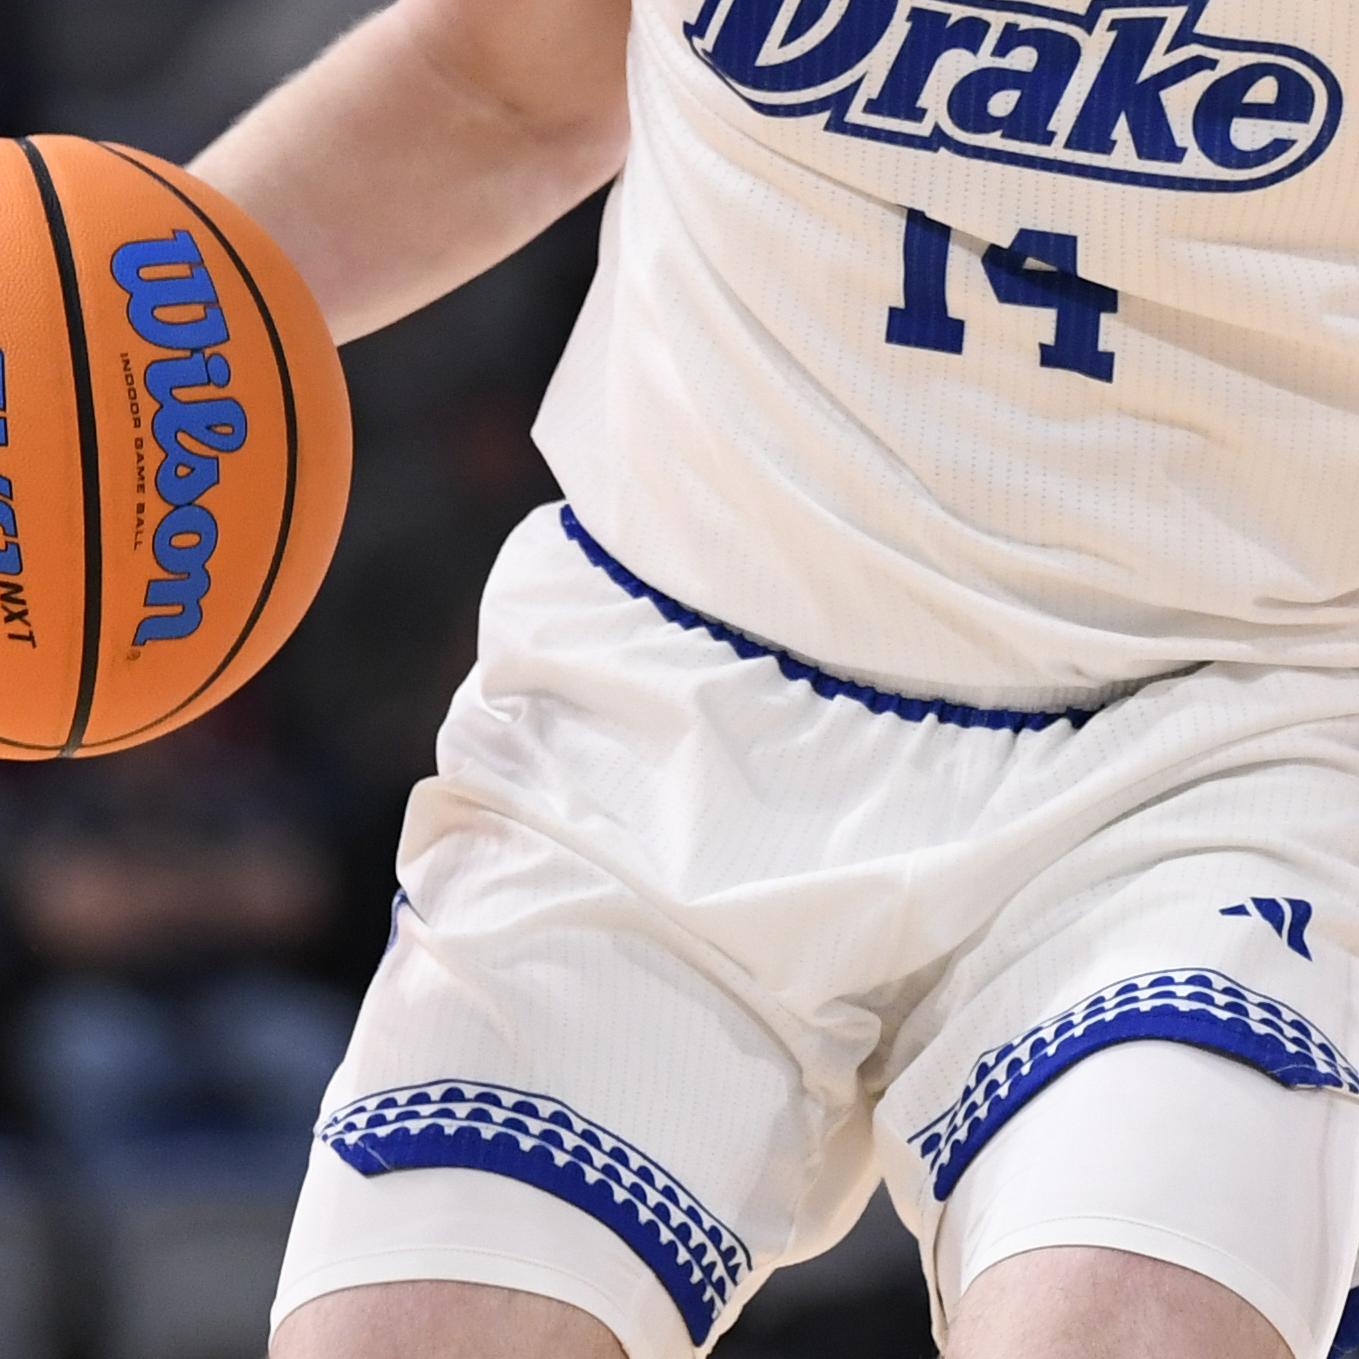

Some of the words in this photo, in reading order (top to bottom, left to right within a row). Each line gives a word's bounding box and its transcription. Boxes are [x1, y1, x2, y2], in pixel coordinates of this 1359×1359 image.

[884, 208, 1119, 384] 14
[119, 352, 142, 430] INDOOR
[110, 228, 248, 648] Wilson
[134, 437, 146, 495] GAME
[133, 502, 146, 552] BALL
